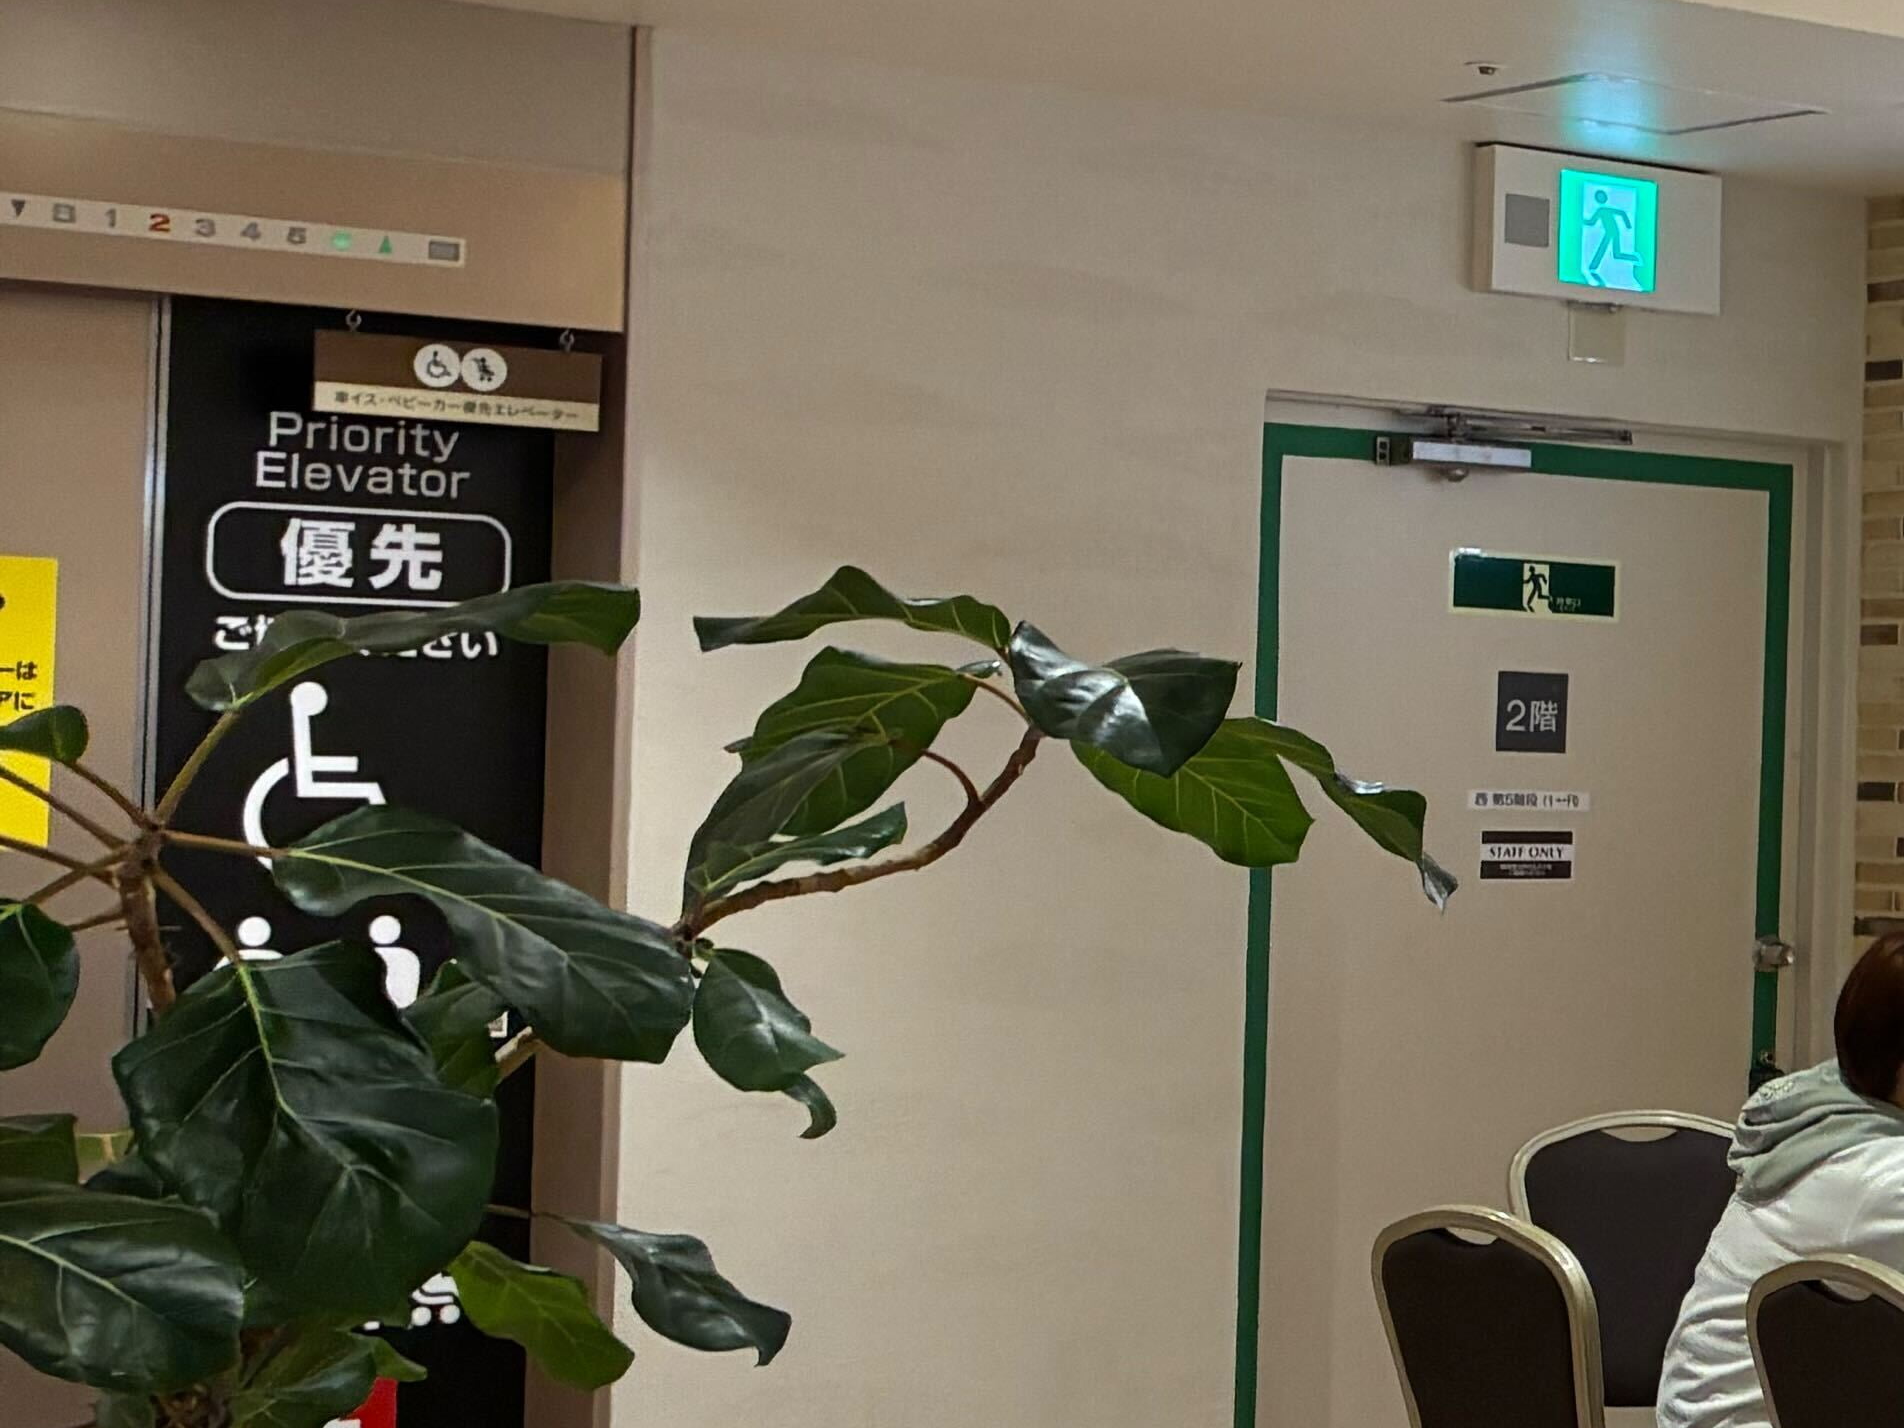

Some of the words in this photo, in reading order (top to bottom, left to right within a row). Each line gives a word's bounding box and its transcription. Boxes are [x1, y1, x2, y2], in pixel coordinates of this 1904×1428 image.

[149, 213, 171, 233] 2
[195, 218, 217, 237] 3
[241, 222, 262, 241] 4
[269, 410, 459, 463] Priority
[255, 450, 470, 499] Elevator
[281, 518, 443, 590] 優先
[1505, 698, 1558, 732] 2階
[1489, 846, 1523, 859] STAFF
[1529, 846, 1564, 859] ONLY
